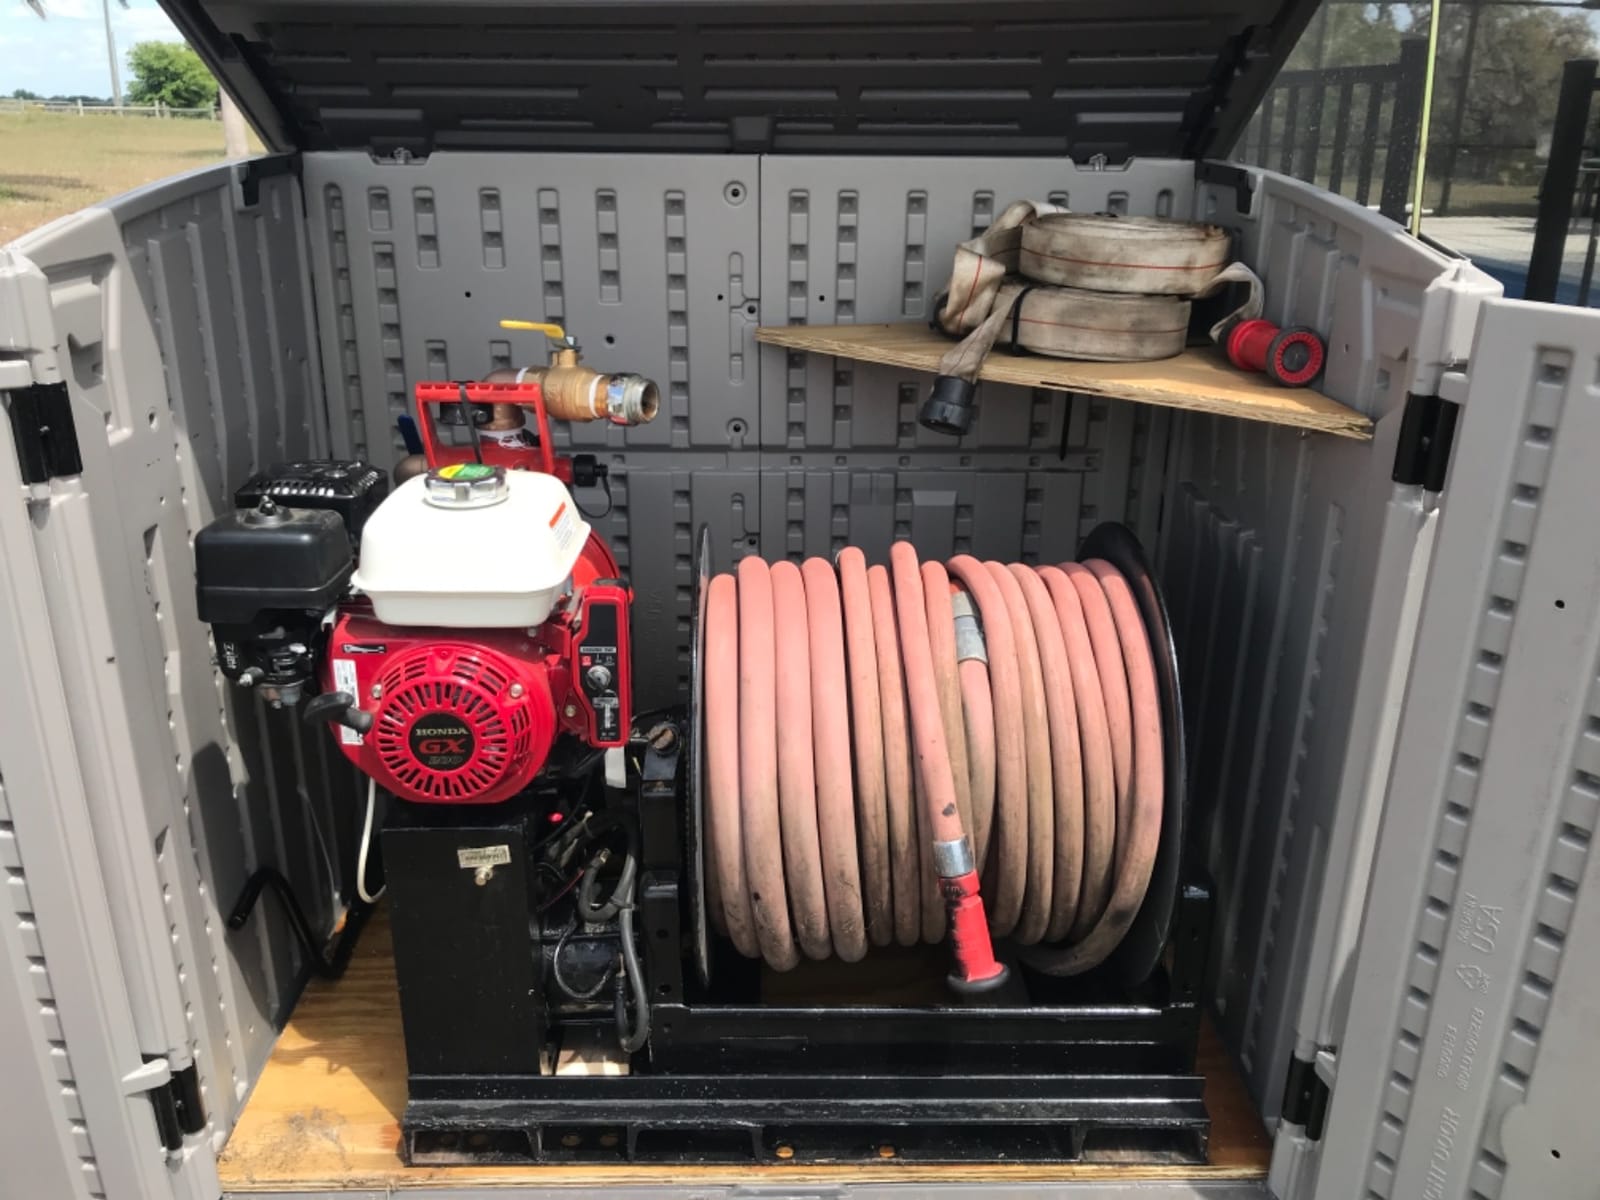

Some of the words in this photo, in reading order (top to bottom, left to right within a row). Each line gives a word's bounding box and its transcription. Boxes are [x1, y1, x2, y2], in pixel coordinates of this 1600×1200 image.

[415, 728, 469, 737] HONDA
[418, 738, 467, 755] GX
[1471, 904, 1504, 953] USA
[1432, 1106, 1460, 1160] DOOR
